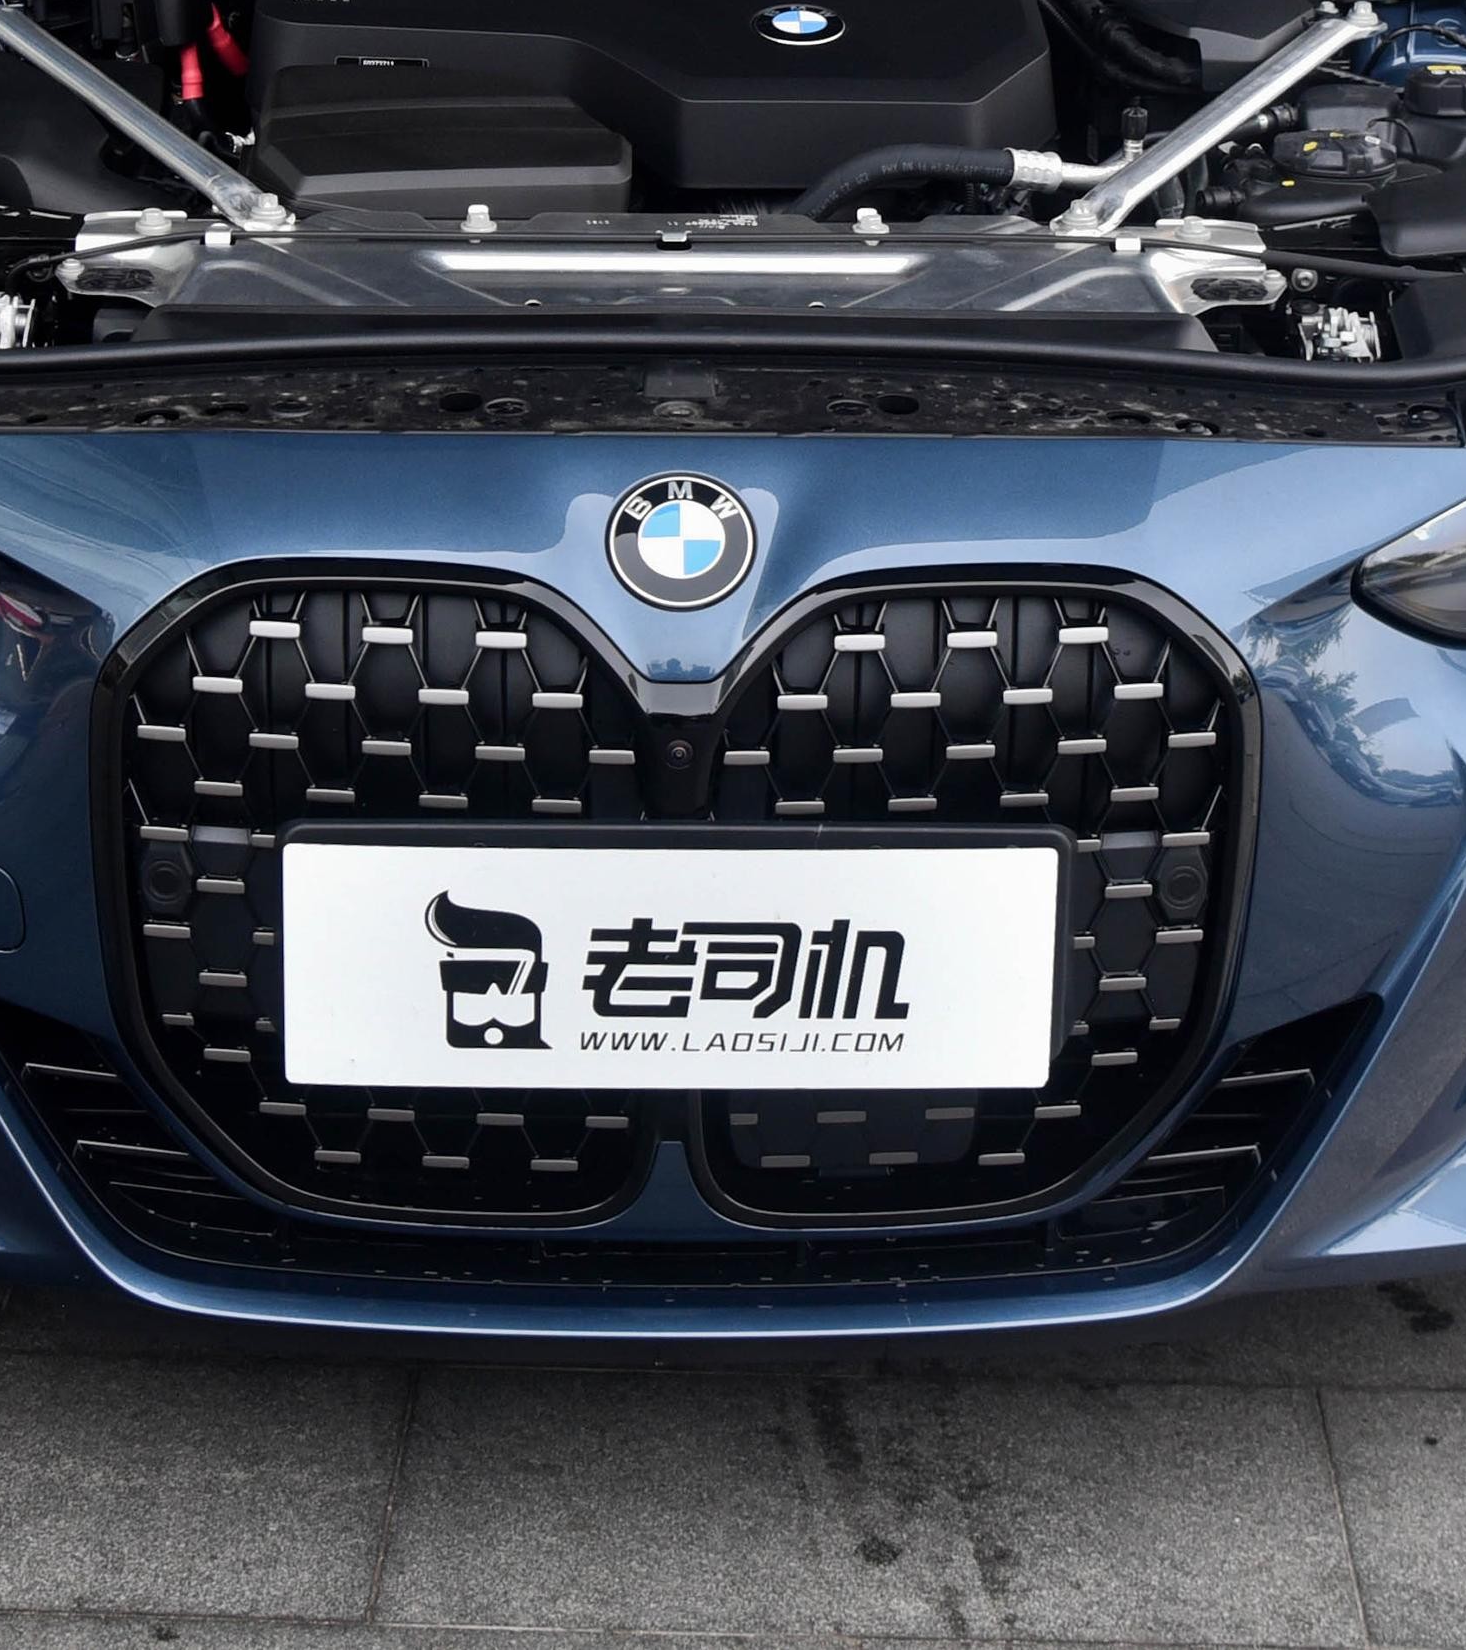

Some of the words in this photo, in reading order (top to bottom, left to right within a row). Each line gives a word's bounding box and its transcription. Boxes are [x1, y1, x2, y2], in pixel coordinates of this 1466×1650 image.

[624, 480, 739, 521] BMW
[582, 917, 910, 1020] 老司机
[579, 1030, 906, 1054] WWW.LAOSIJI.COM
